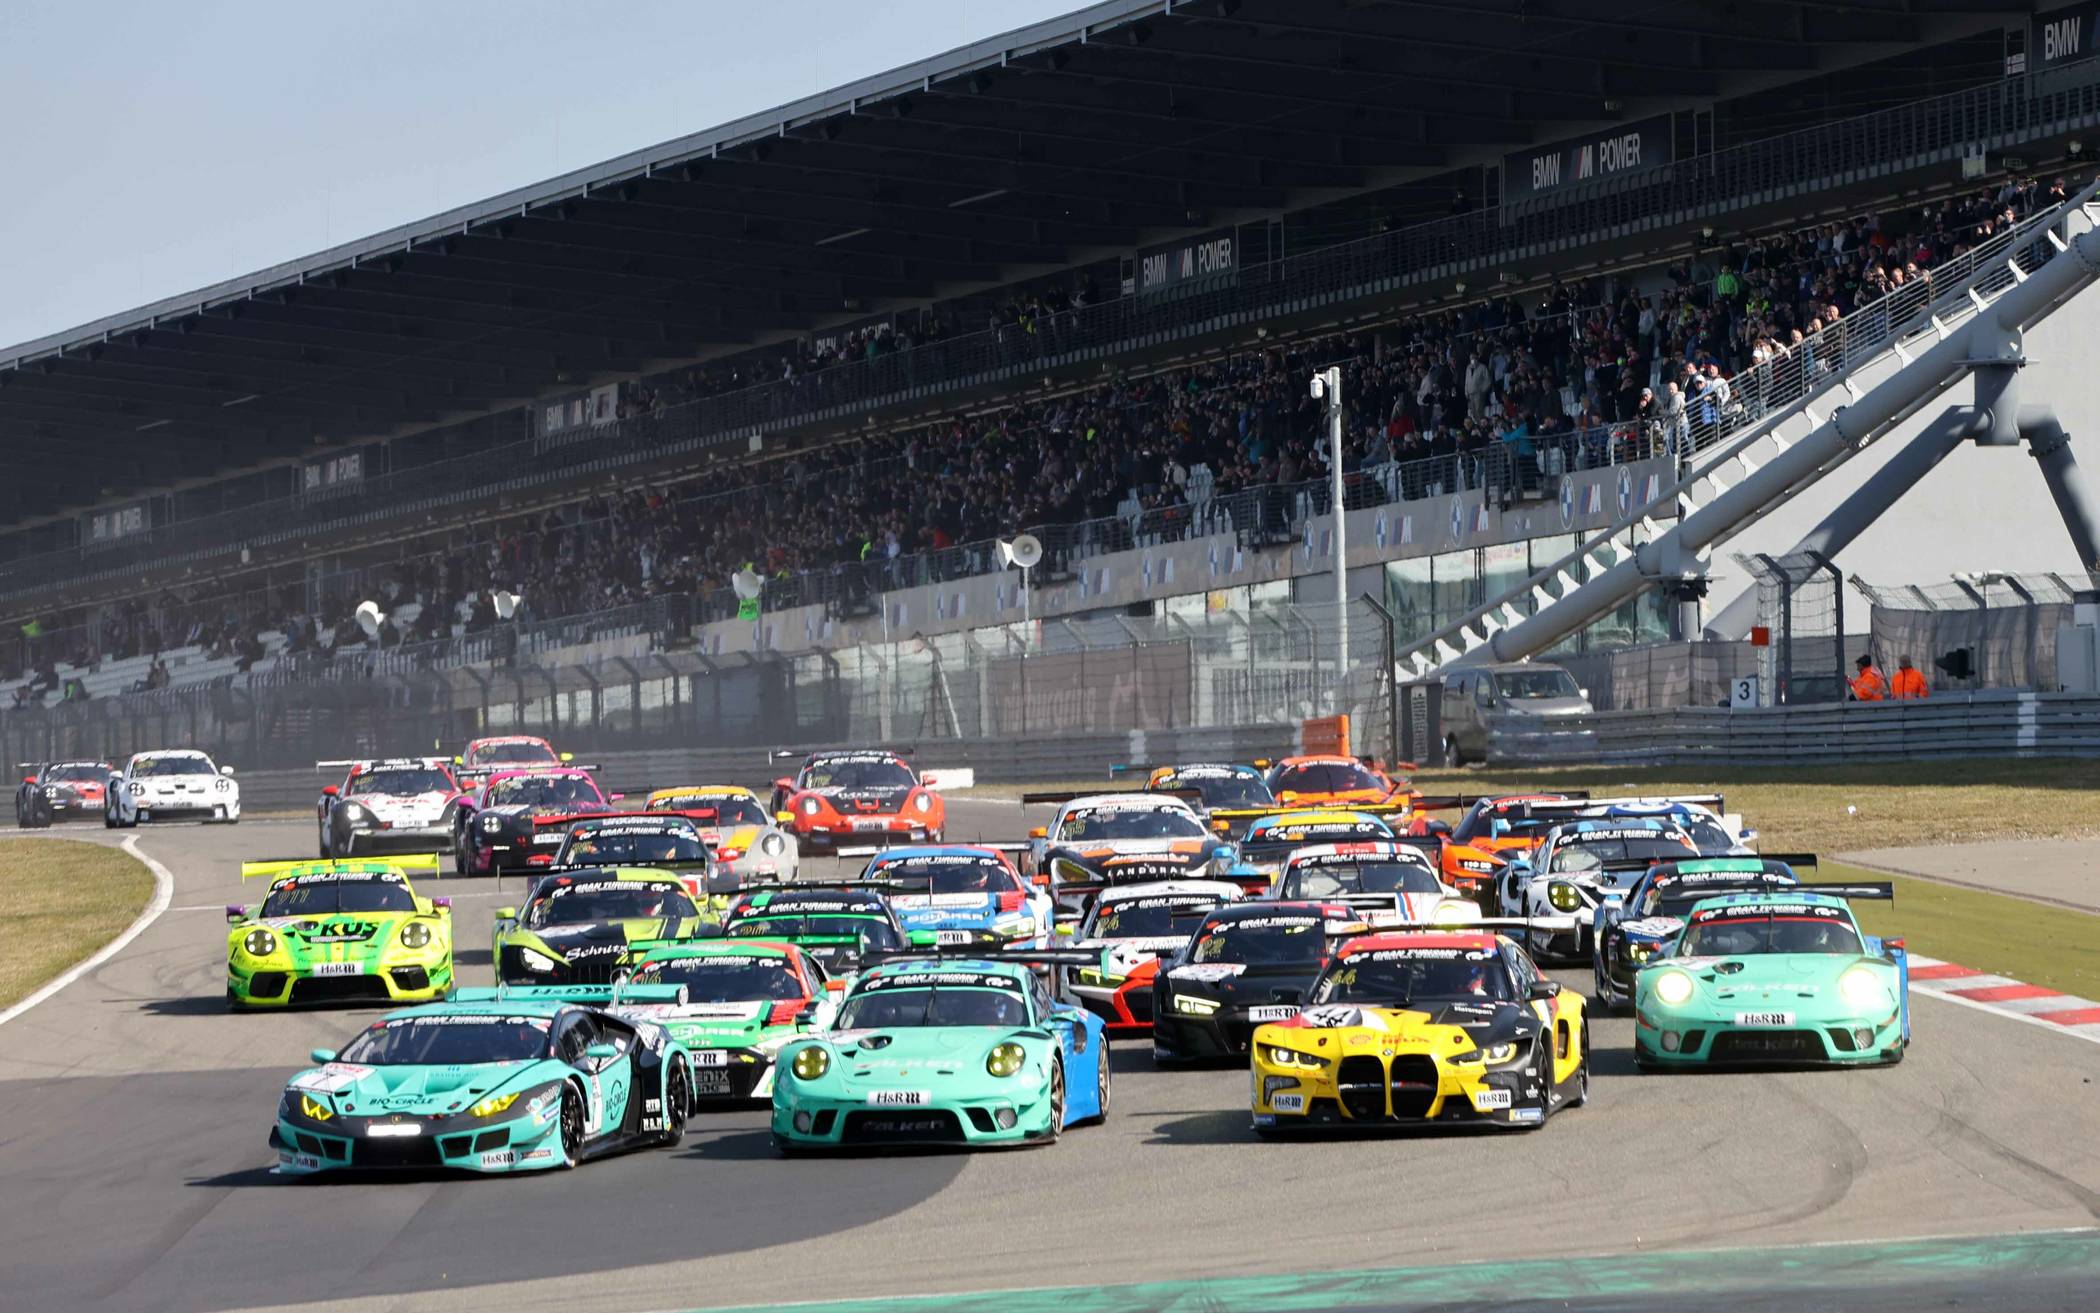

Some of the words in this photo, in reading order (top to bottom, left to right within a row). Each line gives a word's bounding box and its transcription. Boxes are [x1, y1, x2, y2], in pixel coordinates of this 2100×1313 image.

[2045, 16, 2080, 61] BMW
[1533, 152, 1560, 190] BMW
[1600, 132, 1640, 174] POWER
[1143, 253, 1166, 287] BMW
[1199, 238, 1231, 274] POWER
[546, 404, 564, 431] BMW
[1738, 681, 1750, 700] 3
[1287, 826, 1310, 834] GRAN
[1312, 824, 1351, 833] TURISMO
[1582, 831, 1609, 841] GRAN
[906, 857, 930, 866] GRAN
[932, 856, 973, 865] TURISMO
[1321, 855, 1346, 864] GRAN
[1682, 874, 1708, 882] GRAN
[1710, 872, 1754, 880] TURISMO
[575, 883, 600, 894] GRAN
[602, 881, 644, 891] TURISMO
[769, 903, 800, 914] GRAN
[802, 901, 853, 912] TURISMO
[1138, 899, 1165, 909] GRAN
[1167, 897, 1212, 907] TURISMO
[1727, 906, 1756, 916] GRAN
[1758, 905, 1806, 914] TURISMO
[1239, 920, 1267, 930] GRAN
[1269, 917, 1316, 927] TURISMO
[564, 944, 628, 962] Schnitz
[1373, 951, 1404, 962] GRAN
[1406, 949, 1457, 960] TURISMO
[671, 958, 700, 969] GRAN
[703, 956, 751, 966] TURISMO
[321, 964, 342, 974] H&R
[894, 975, 925, 986] GRAN
[927, 973, 978, 985] TURISMO
[1259, 1008, 1282, 1018] H&R
[1454, 1005, 1493, 1016] Motorsport
[415, 1017, 446, 1027] GRAN
[1745, 1013, 1769, 1025] H&R
[369, 1097, 435, 1106] BIO-CIRCLE
[606, 1087, 627, 1112] BIO-CIRCLE
[877, 1091, 903, 1104] H&R
[1275, 1096, 1291, 1107] H&R
[1479, 1093, 1498, 1104] H&R
[482, 1152, 502, 1165] H&R
